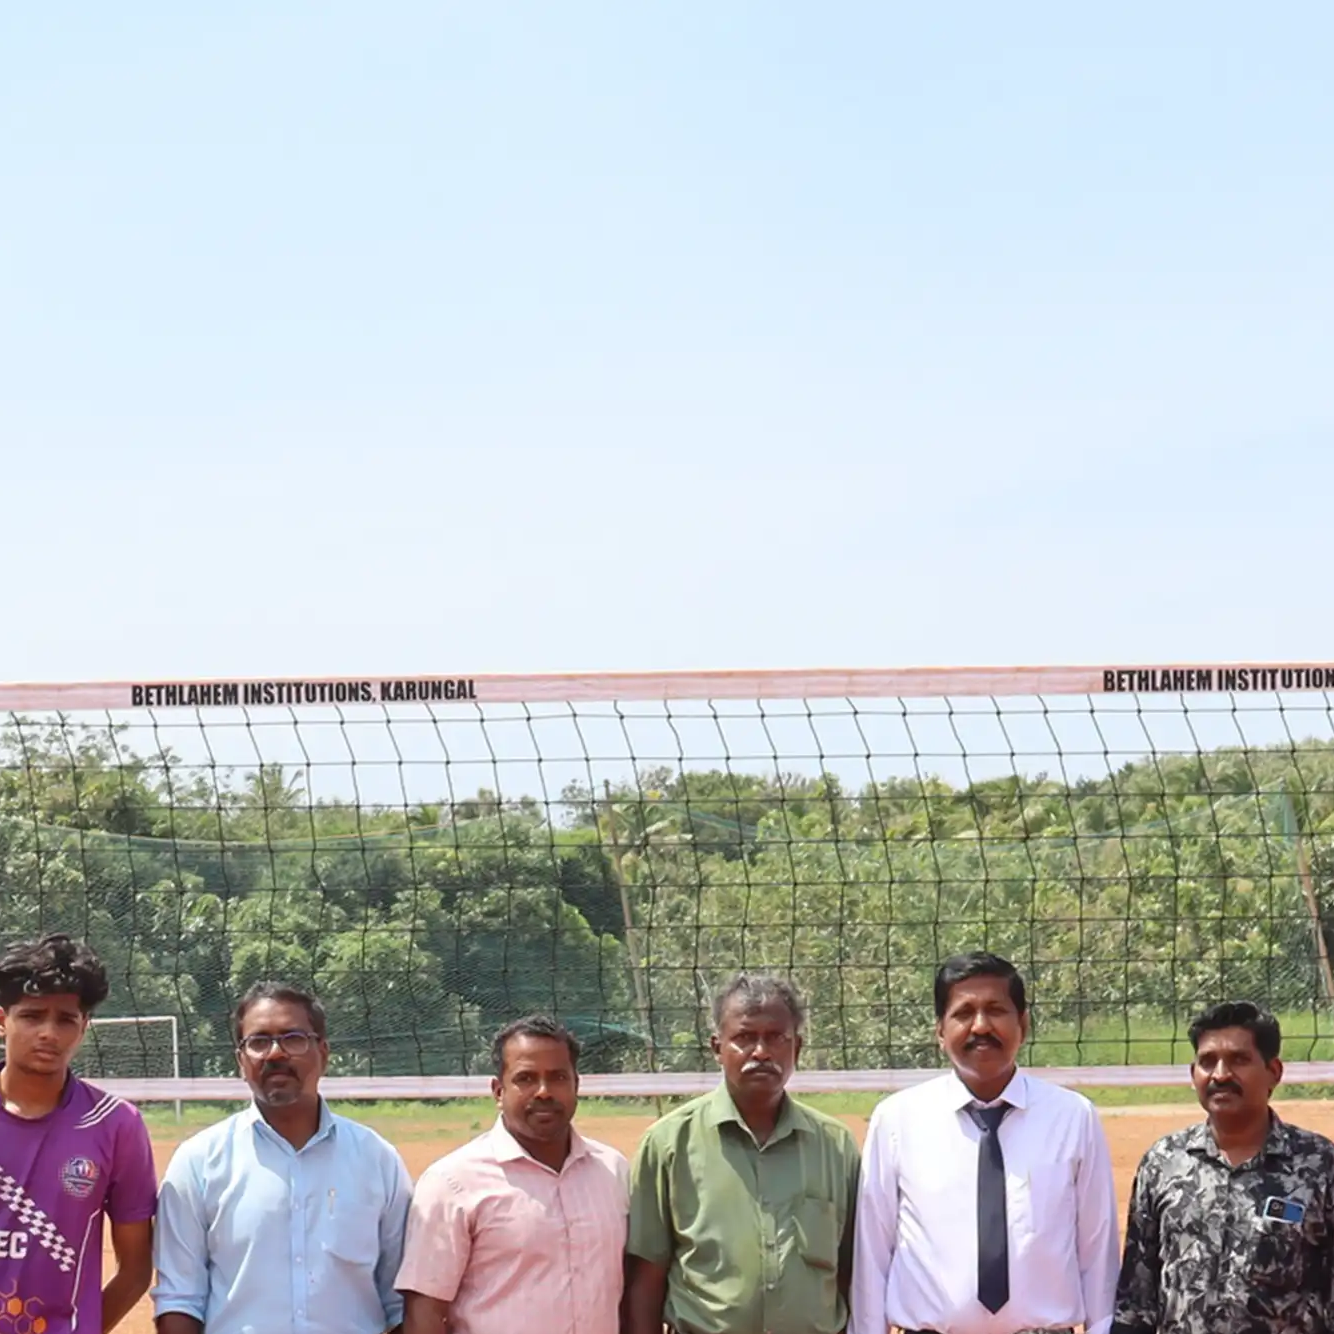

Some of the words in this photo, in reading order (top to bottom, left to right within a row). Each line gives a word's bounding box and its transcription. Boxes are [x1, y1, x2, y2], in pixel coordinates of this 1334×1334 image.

[131, 684, 239, 707] BETHLAHEM
[243, 681, 377, 705] INSTITUTIONS,
[380, 679, 477, 702] KARUNGAL
[1103, 669, 1213, 692] BETHLAHEM
